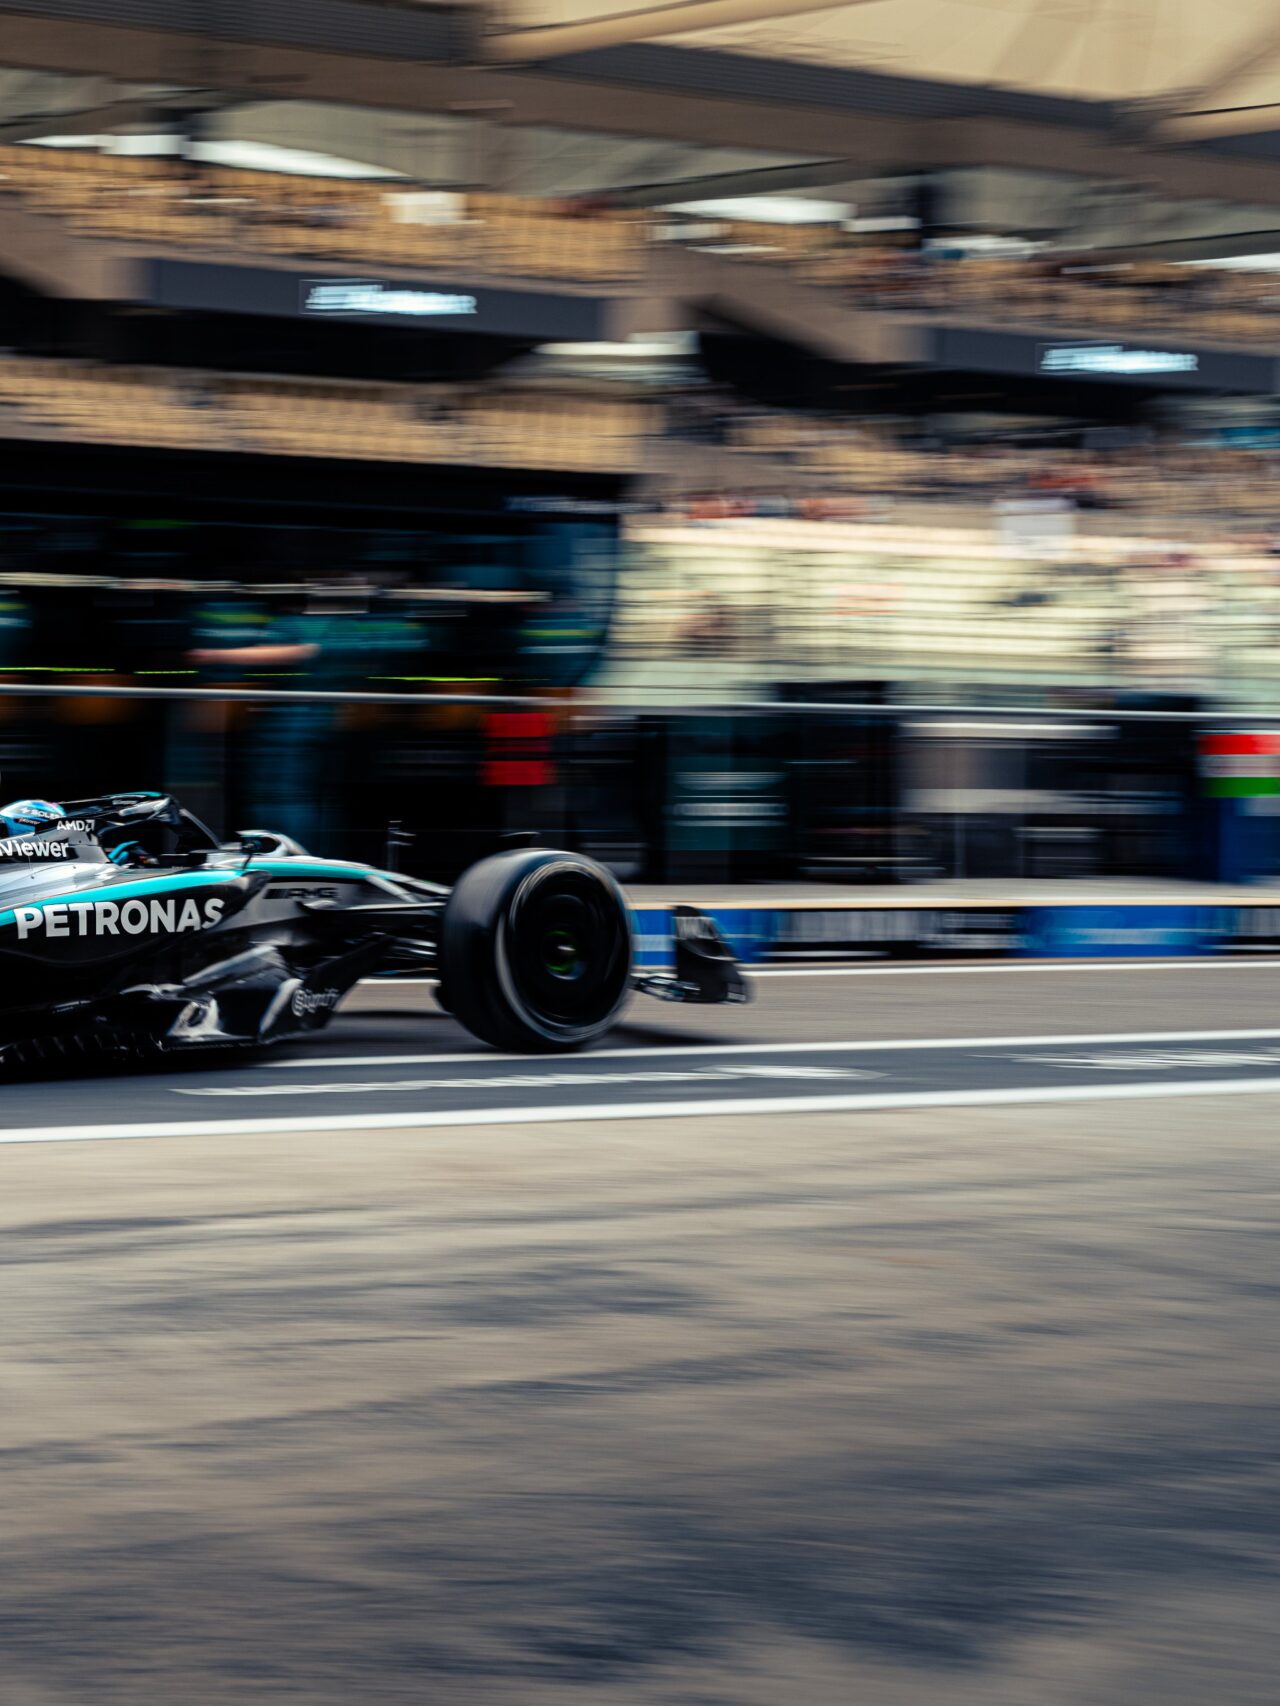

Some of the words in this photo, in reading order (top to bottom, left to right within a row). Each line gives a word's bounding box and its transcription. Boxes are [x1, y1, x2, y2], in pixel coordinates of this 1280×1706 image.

[31, 809, 63, 820] SOLER
[57, 820, 85, 831] AMD
[14, 898, 225, 940] PETRONAS
